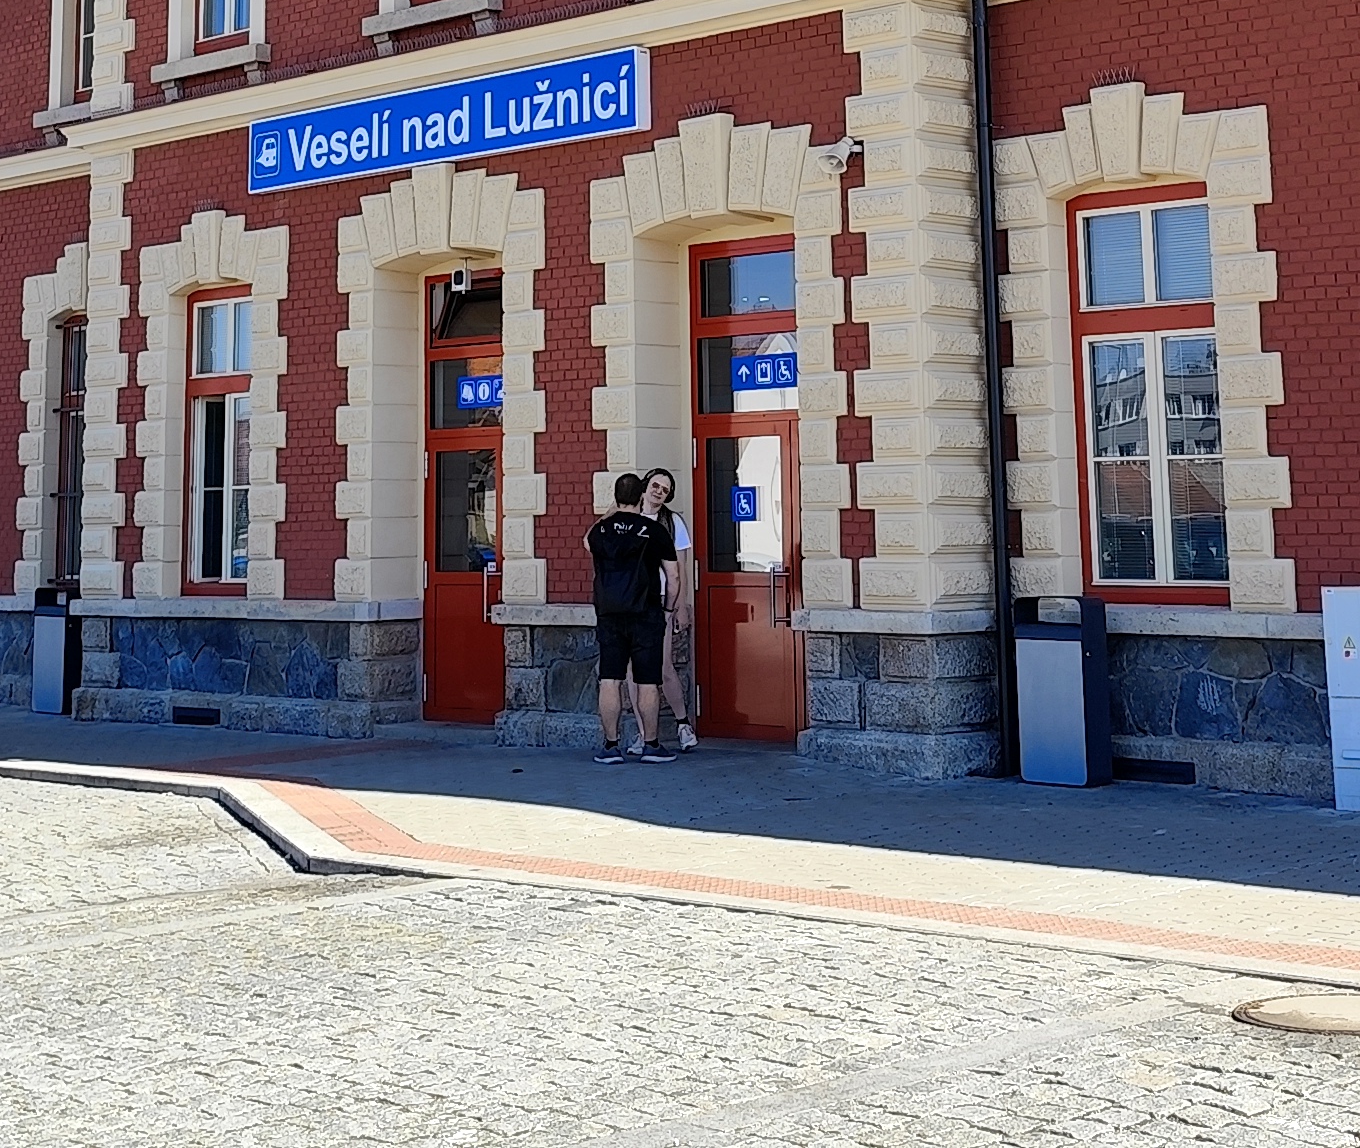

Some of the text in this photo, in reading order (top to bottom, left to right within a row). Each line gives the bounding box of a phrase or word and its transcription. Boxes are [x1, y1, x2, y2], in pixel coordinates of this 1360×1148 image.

[287, 63, 631, 172] Veselí nad Lužnicí
